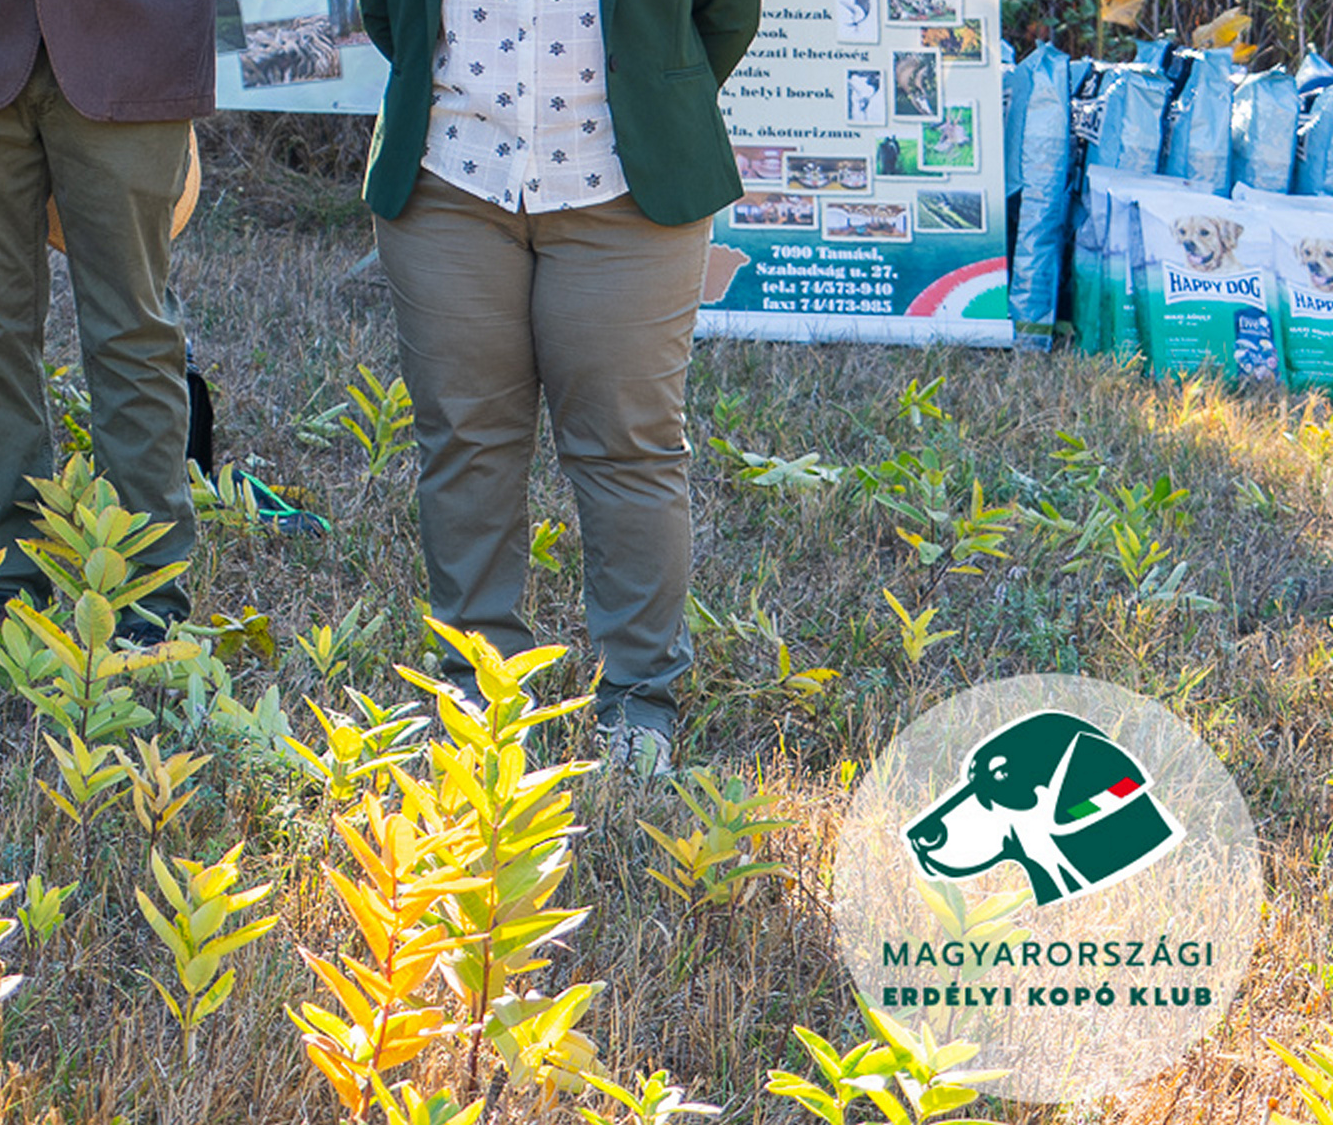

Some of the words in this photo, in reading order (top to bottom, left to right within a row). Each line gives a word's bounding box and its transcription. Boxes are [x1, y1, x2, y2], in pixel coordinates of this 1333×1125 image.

[793, 47, 869, 62] lehetőség
[732, 66, 770, 78] adás
[740, 86, 781, 100] helyi
[786, 87, 834, 99] borok
[771, 245, 813, 259] 7090
[756, 262, 846, 279] Szabadság
[849, 268, 867, 279] u.
[870, 265, 899, 279] 27.
[1169, 272, 1222, 293] HAPPY
[1226, 276, 1261, 299] DOG
[762, 297, 796, 310] fax:
[1294, 291, 1333, 312] HAPP
